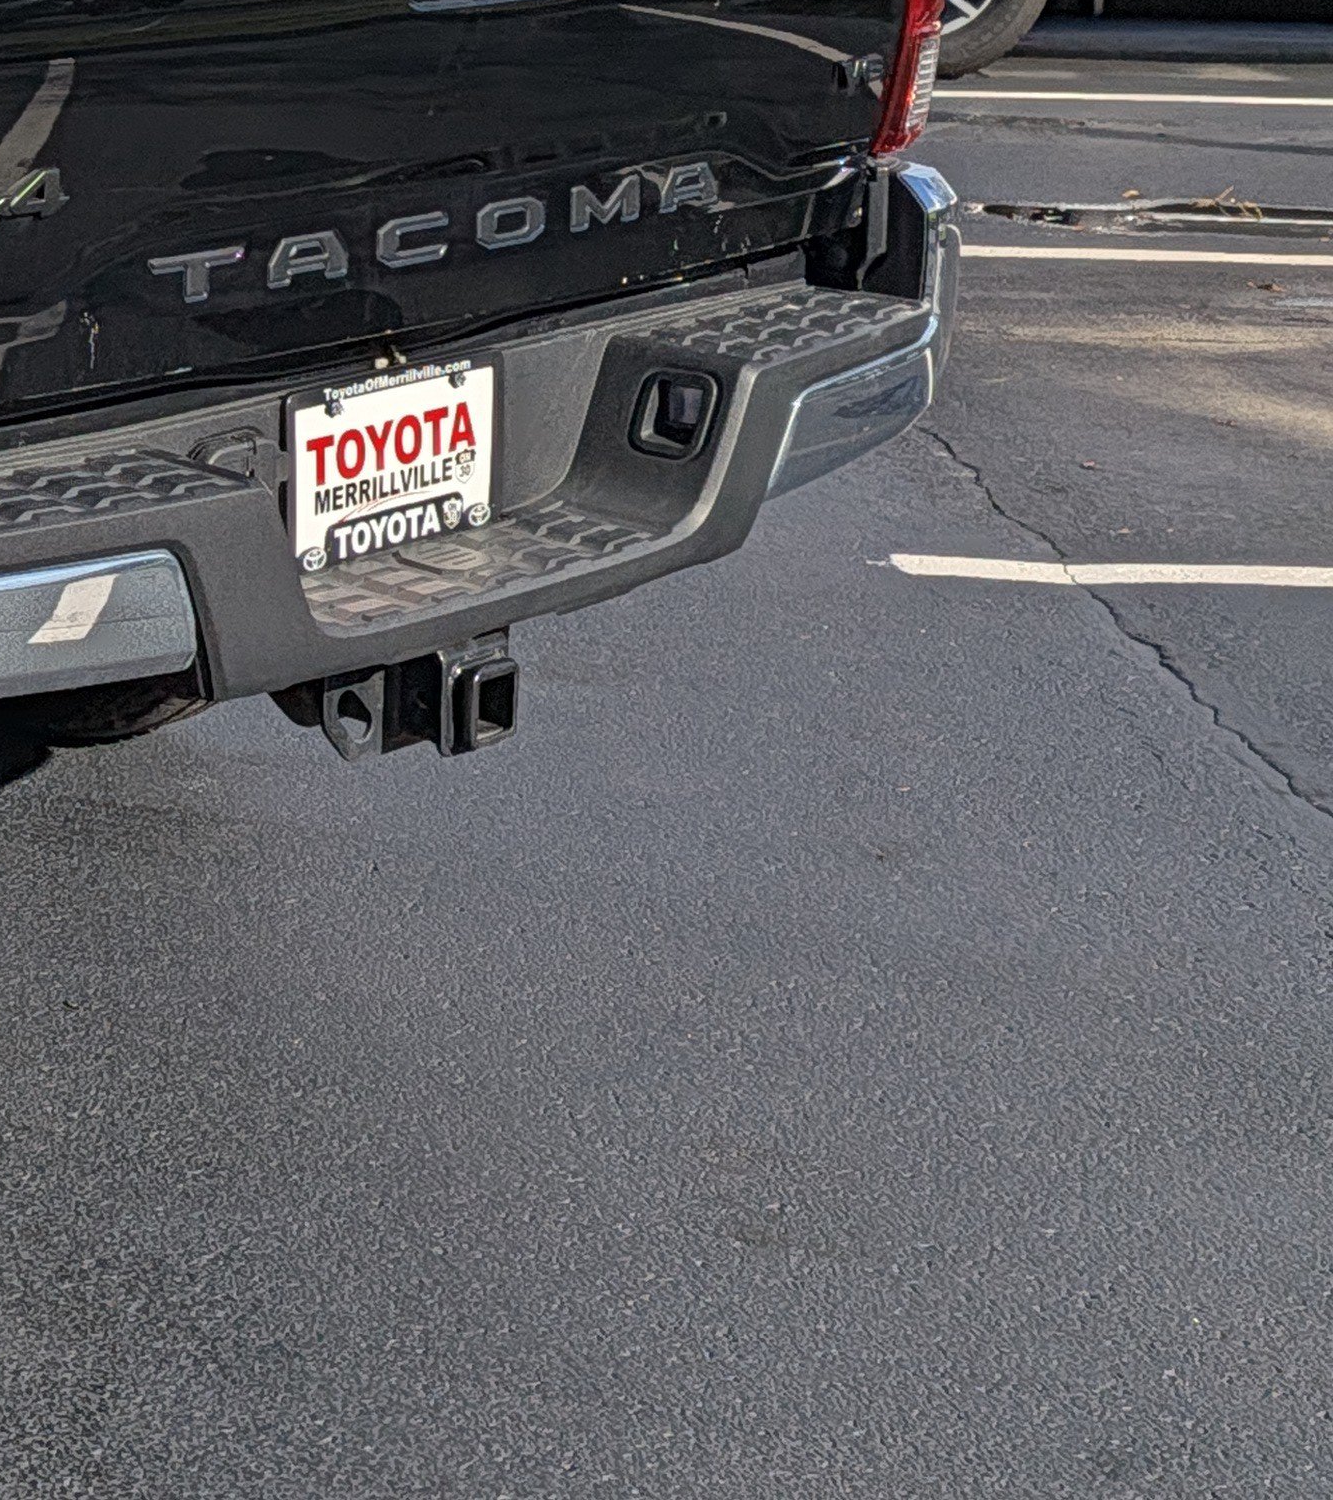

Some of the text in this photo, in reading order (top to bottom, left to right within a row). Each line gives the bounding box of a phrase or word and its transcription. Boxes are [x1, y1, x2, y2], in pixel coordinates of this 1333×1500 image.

[147, 160, 720, 304] TACOMA
[323, 359, 472, 402] ToyotaOfMerrillville.com
[306, 402, 477, 487] TOYOTA
[314, 456, 453, 516] MERRILLVILLE
[334, 503, 441, 560] TOYOTA
